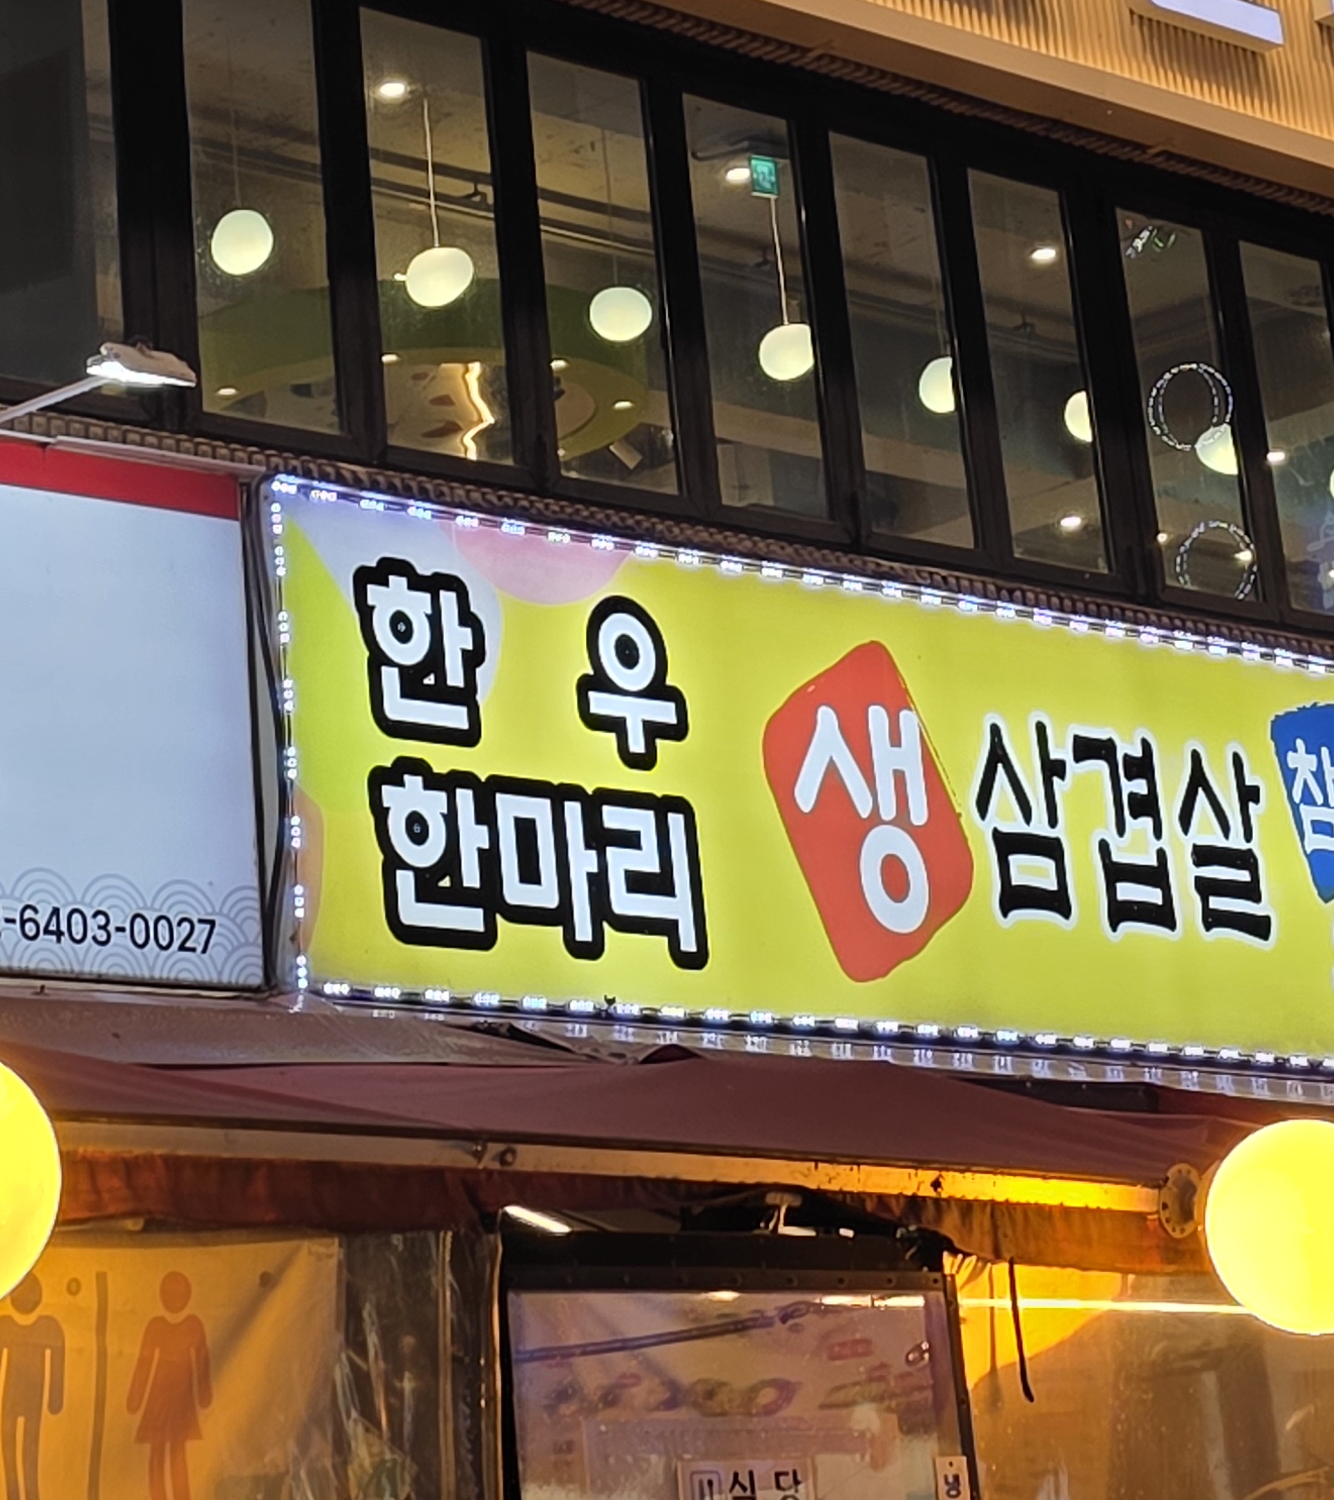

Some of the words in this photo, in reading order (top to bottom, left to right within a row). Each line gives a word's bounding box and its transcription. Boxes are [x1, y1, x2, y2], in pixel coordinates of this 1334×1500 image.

[354, 556, 688, 770] 한우
[368, 757, 709, 970] 한마리
[793, 702, 933, 934] 생
[976, 716, 1273, 942] 삼겹살
